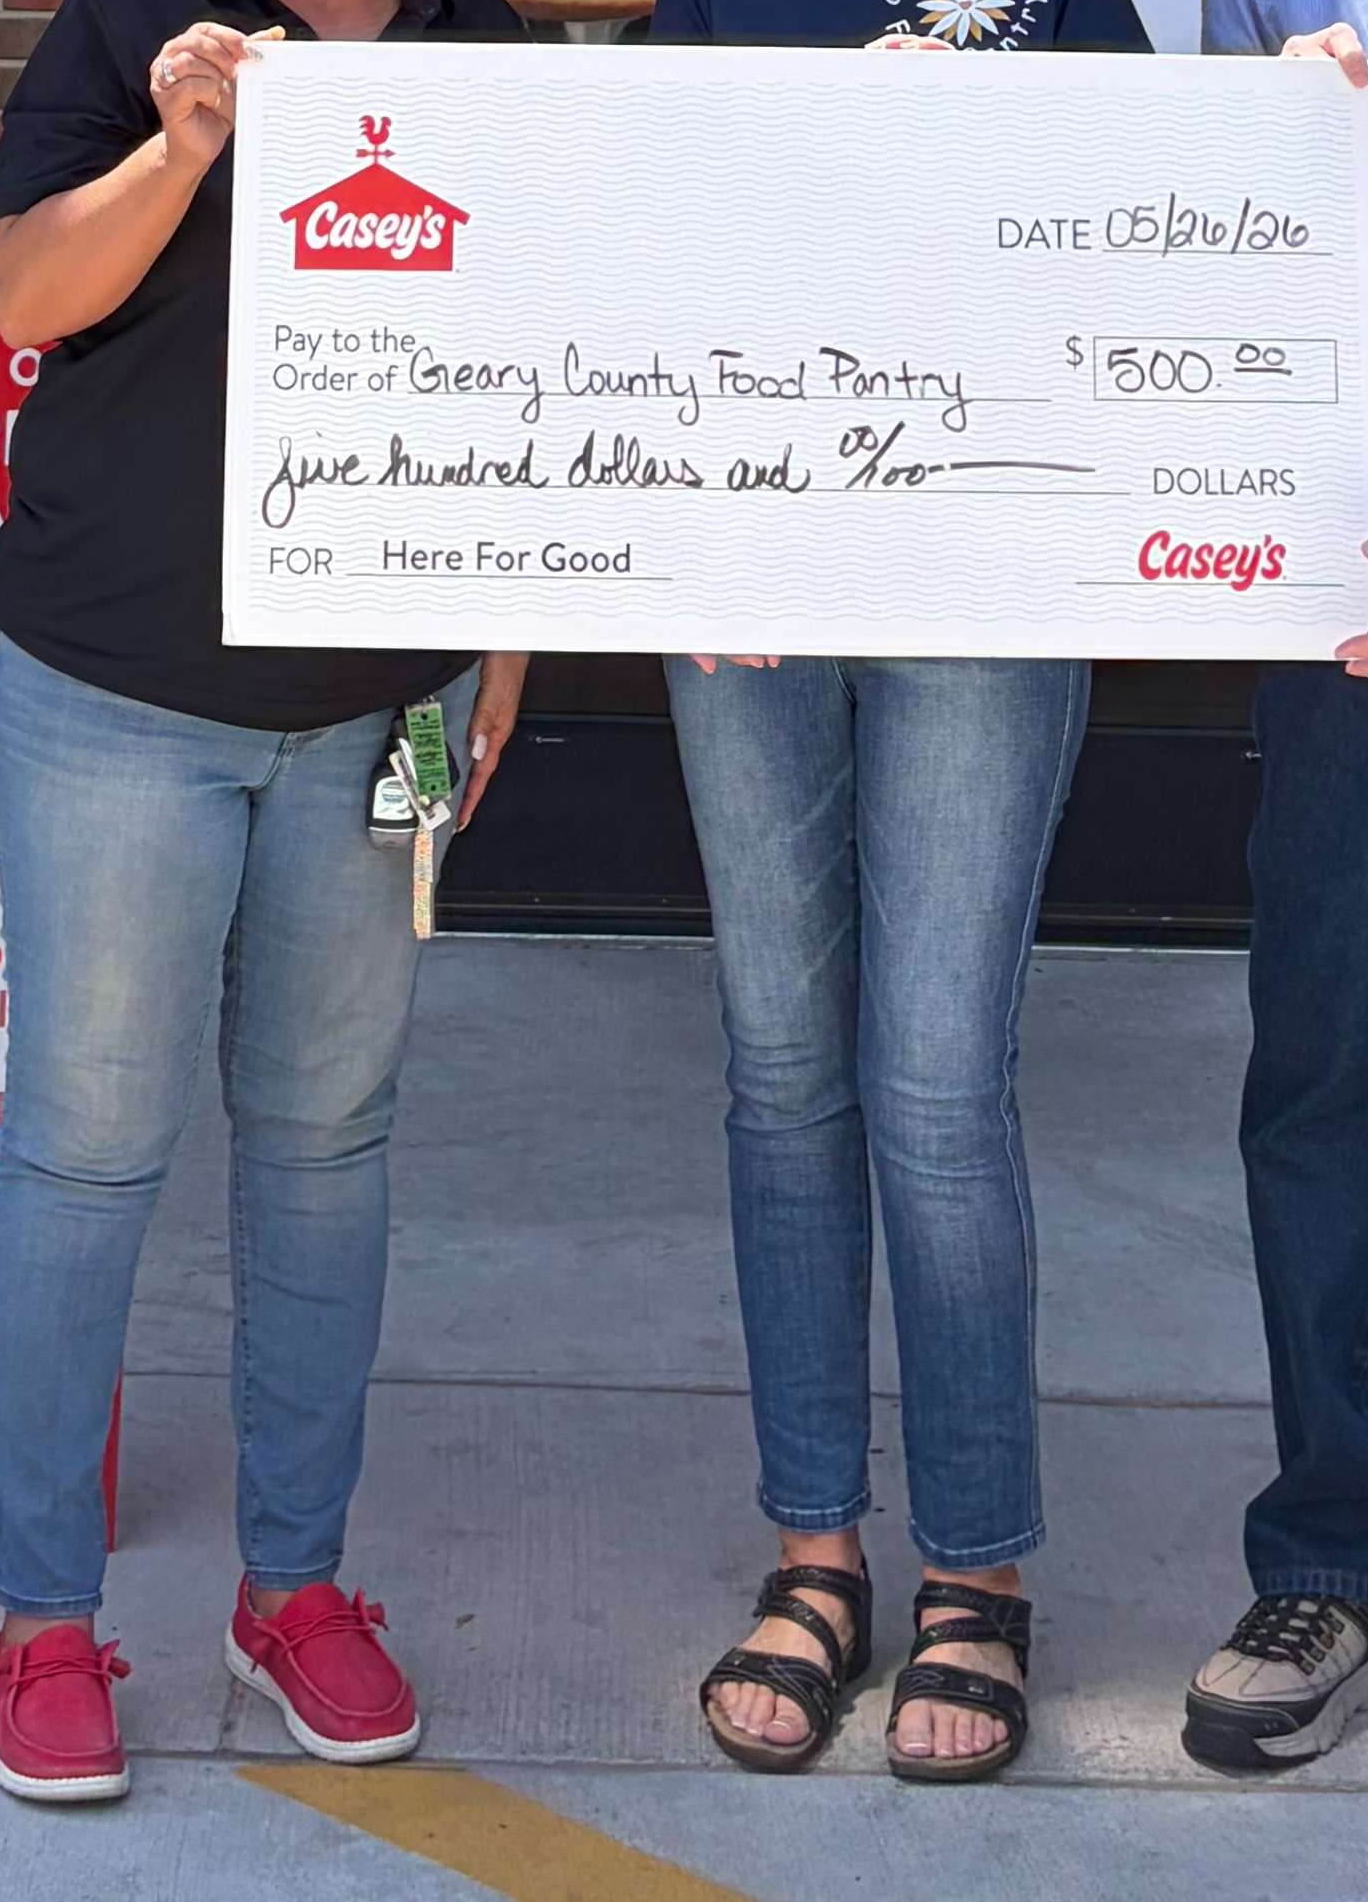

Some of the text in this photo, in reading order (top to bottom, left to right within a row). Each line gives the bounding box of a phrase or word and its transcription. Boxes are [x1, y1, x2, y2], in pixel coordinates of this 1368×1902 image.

[305, 201, 445, 259] Casey's
[997, 218, 1091, 251] DATE
[1105, 192, 1311, 259] 05/26/26
[274, 324, 417, 360] Pay to the
[1065, 335, 1085, 370] $
[273, 363, 400, 392] Order of
[409, 341, 973, 433] Geary County Food Pantry
[262, 432, 369, 529] five
[377, 432, 550, 489] hundred
[567, 428, 705, 490] dollars
[727, 443, 811, 493] and
[1152, 467, 1297, 497] DOLLARS
[268, 540, 632, 576] FOR Here For Good
[1137, 530, 1286, 591] Casey's
